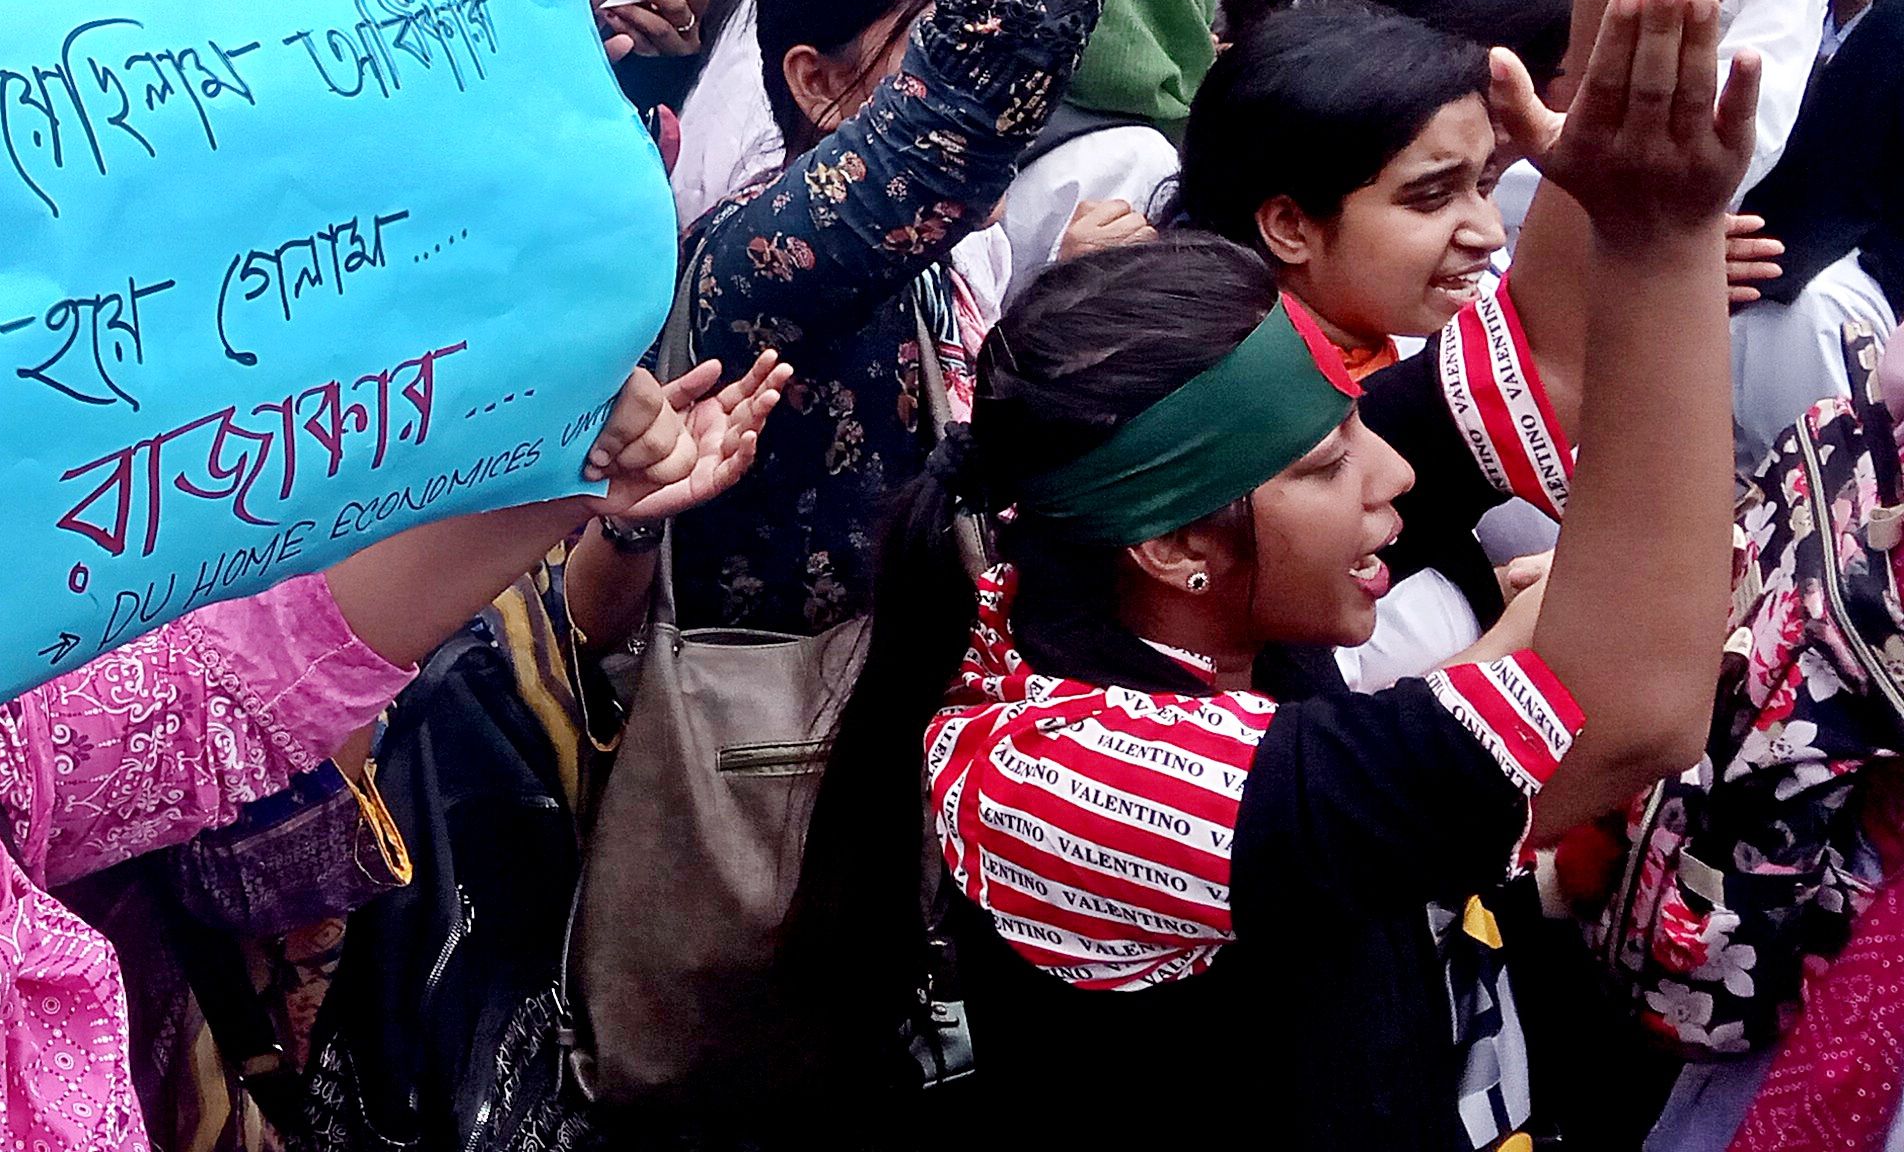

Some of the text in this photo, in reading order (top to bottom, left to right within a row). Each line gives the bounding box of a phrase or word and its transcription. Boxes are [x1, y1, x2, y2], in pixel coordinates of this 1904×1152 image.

[1520, 414, 1570, 508] LENTINO
[98, 567, 176, 650] DU
[179, 519, 317, 598] HOME
[328, 436, 545, 540] ECONOMICES
[1489, 659, 1567, 751] ALENTINO
[1070, 779, 1191, 837] VALENTINO
[981, 854, 1048, 897] LENTINO
[1061, 890, 1198, 935] VALENTINO
[1057, 836, 1188, 893] VALENTINO
